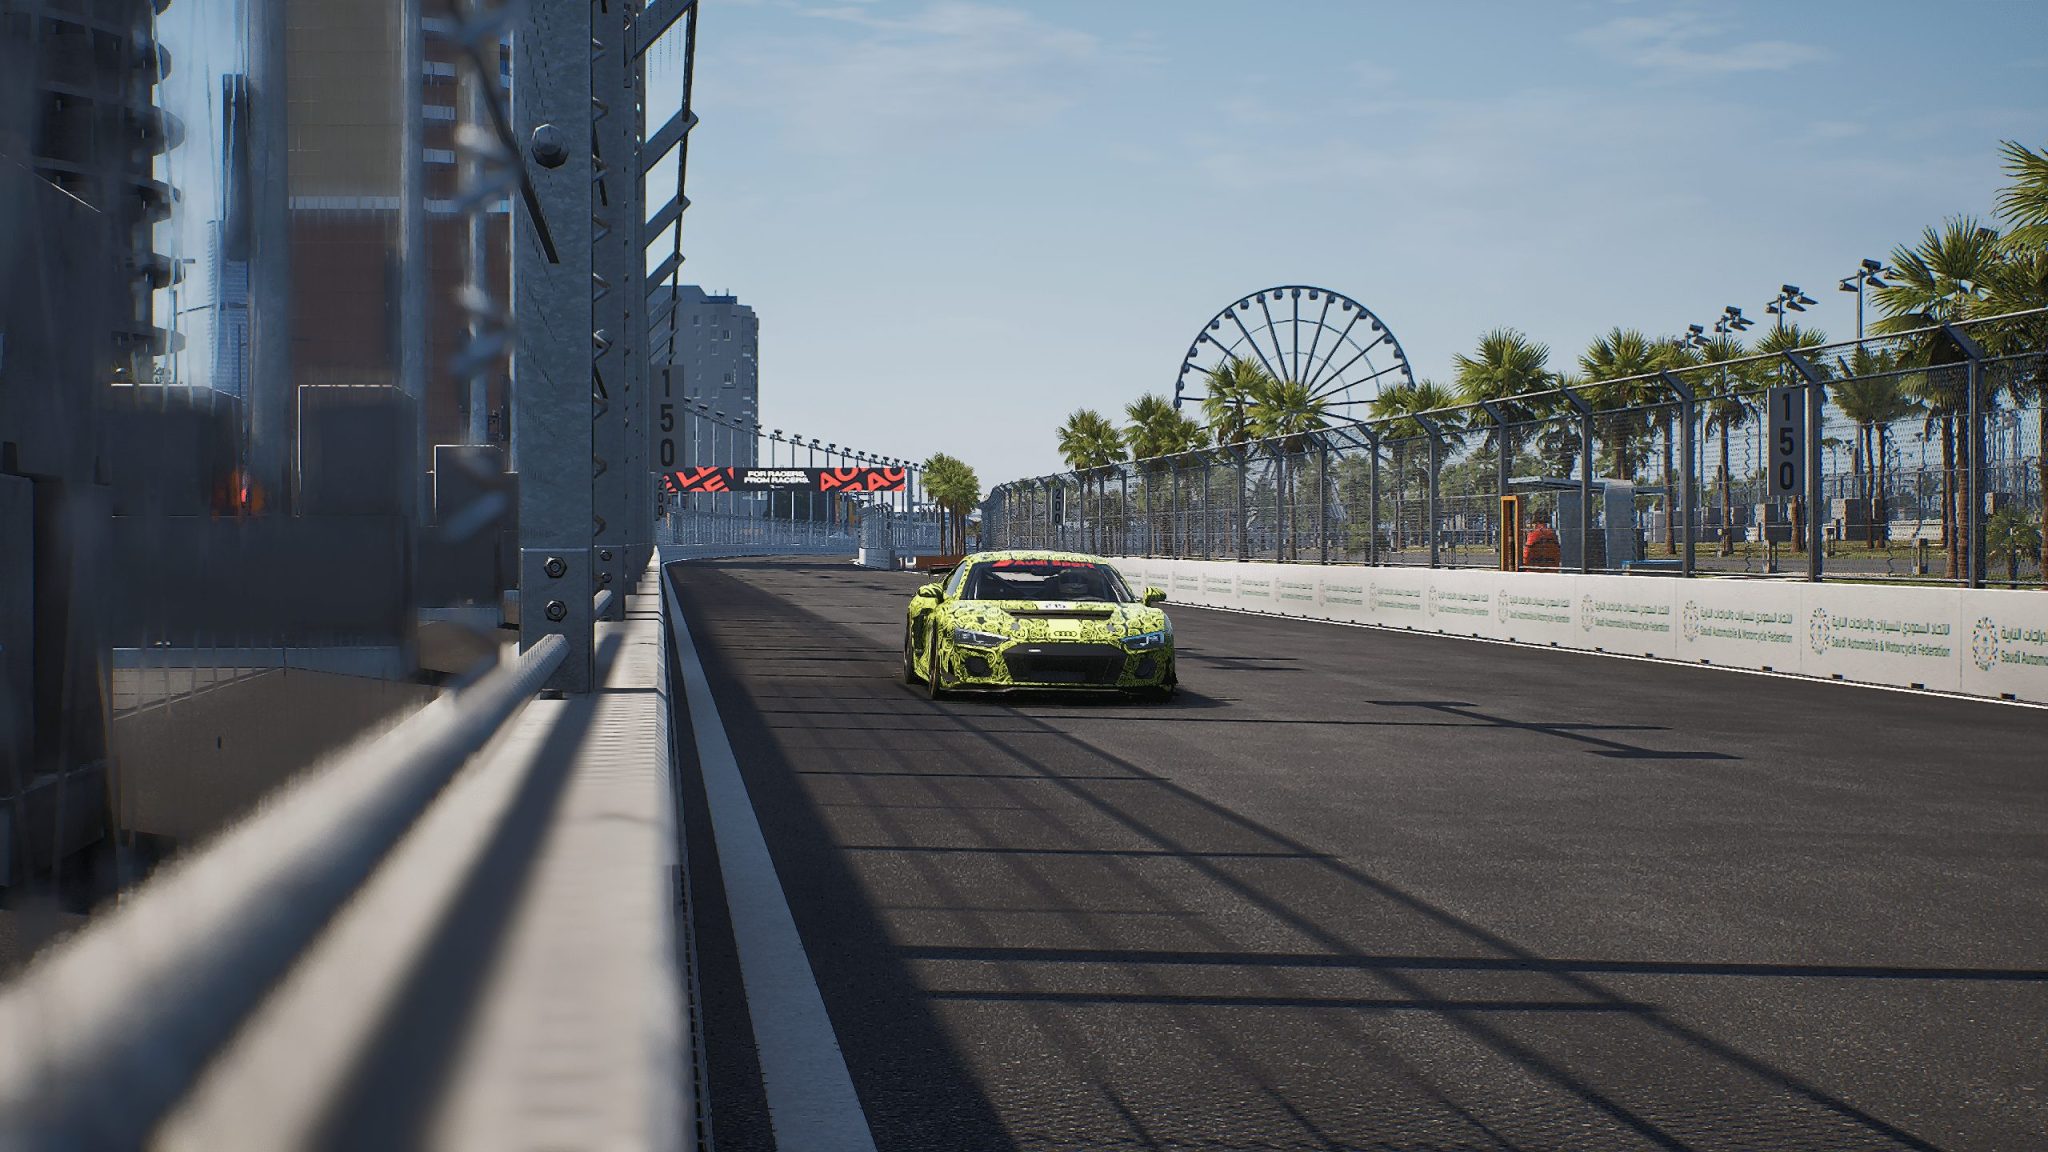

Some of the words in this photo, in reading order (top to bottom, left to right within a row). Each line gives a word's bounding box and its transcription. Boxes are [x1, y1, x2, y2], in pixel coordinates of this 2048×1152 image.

[660, 369, 675, 467] 150
[1780, 393, 1794, 490] 150
[743, 476, 770, 484] FROM
[1052, 560, 1096, 569] Sport
[2001, 650, 2021, 663] Saudi
